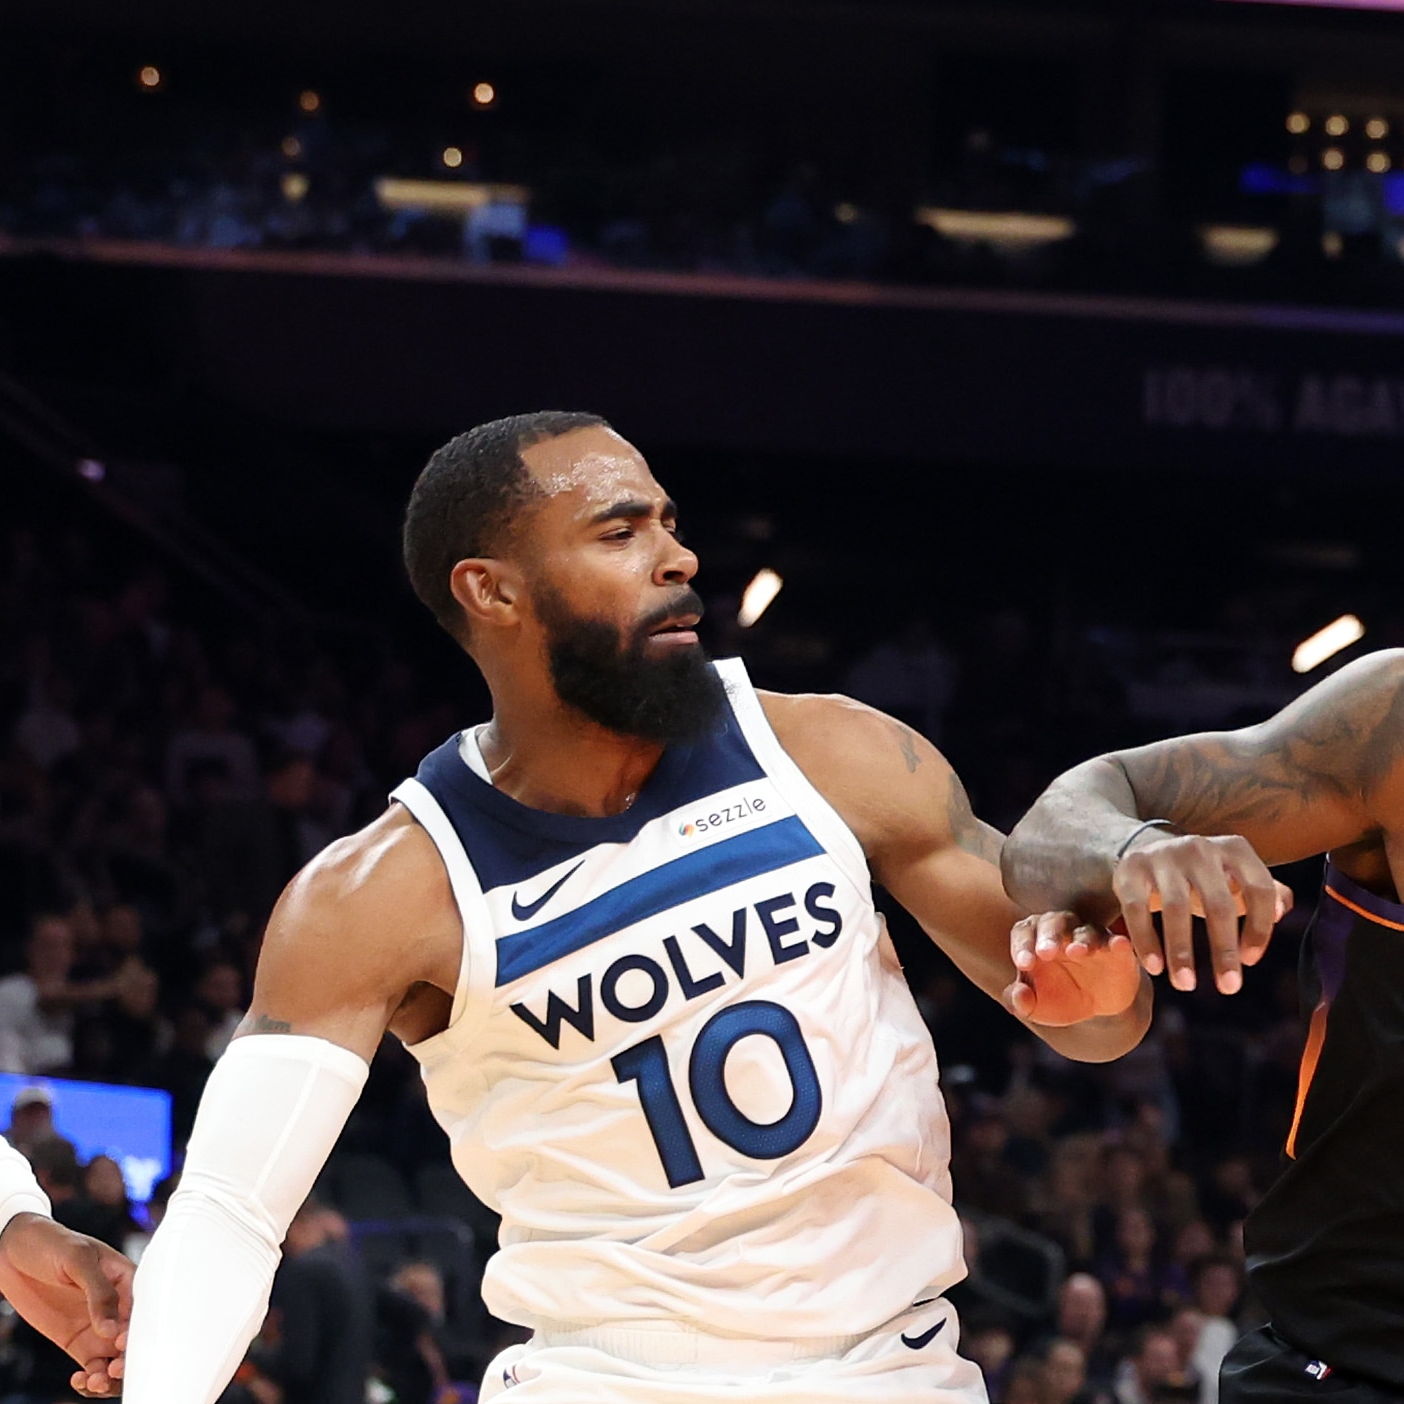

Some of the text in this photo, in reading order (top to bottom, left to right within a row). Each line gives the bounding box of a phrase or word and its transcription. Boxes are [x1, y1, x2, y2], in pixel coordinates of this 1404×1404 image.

[694, 795, 767, 834] sezzle
[509, 881, 843, 1051] WOLVES
[609, 998, 823, 1189] 10
